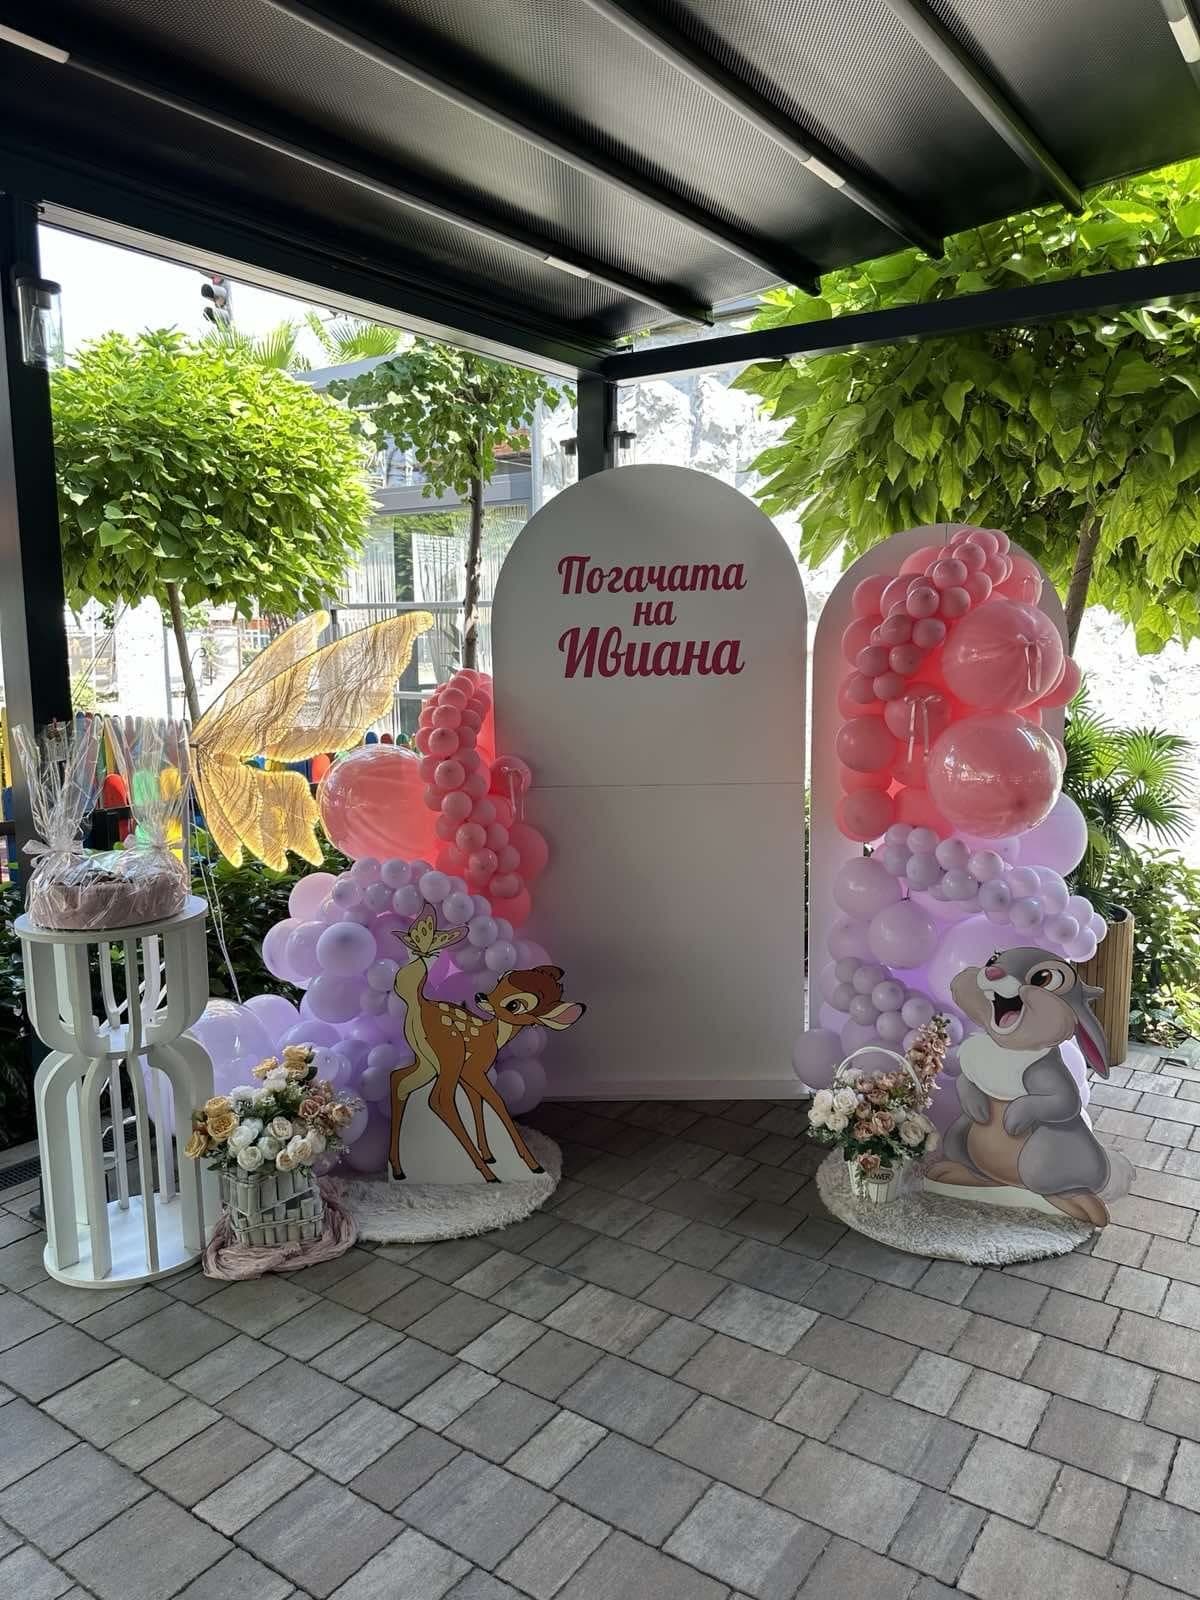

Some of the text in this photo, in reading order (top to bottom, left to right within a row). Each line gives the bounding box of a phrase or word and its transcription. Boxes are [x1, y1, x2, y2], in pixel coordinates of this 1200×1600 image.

[558, 556, 747, 594] Погачата
[633, 601, 676, 626] на
[558, 626, 745, 678] Ивиана
